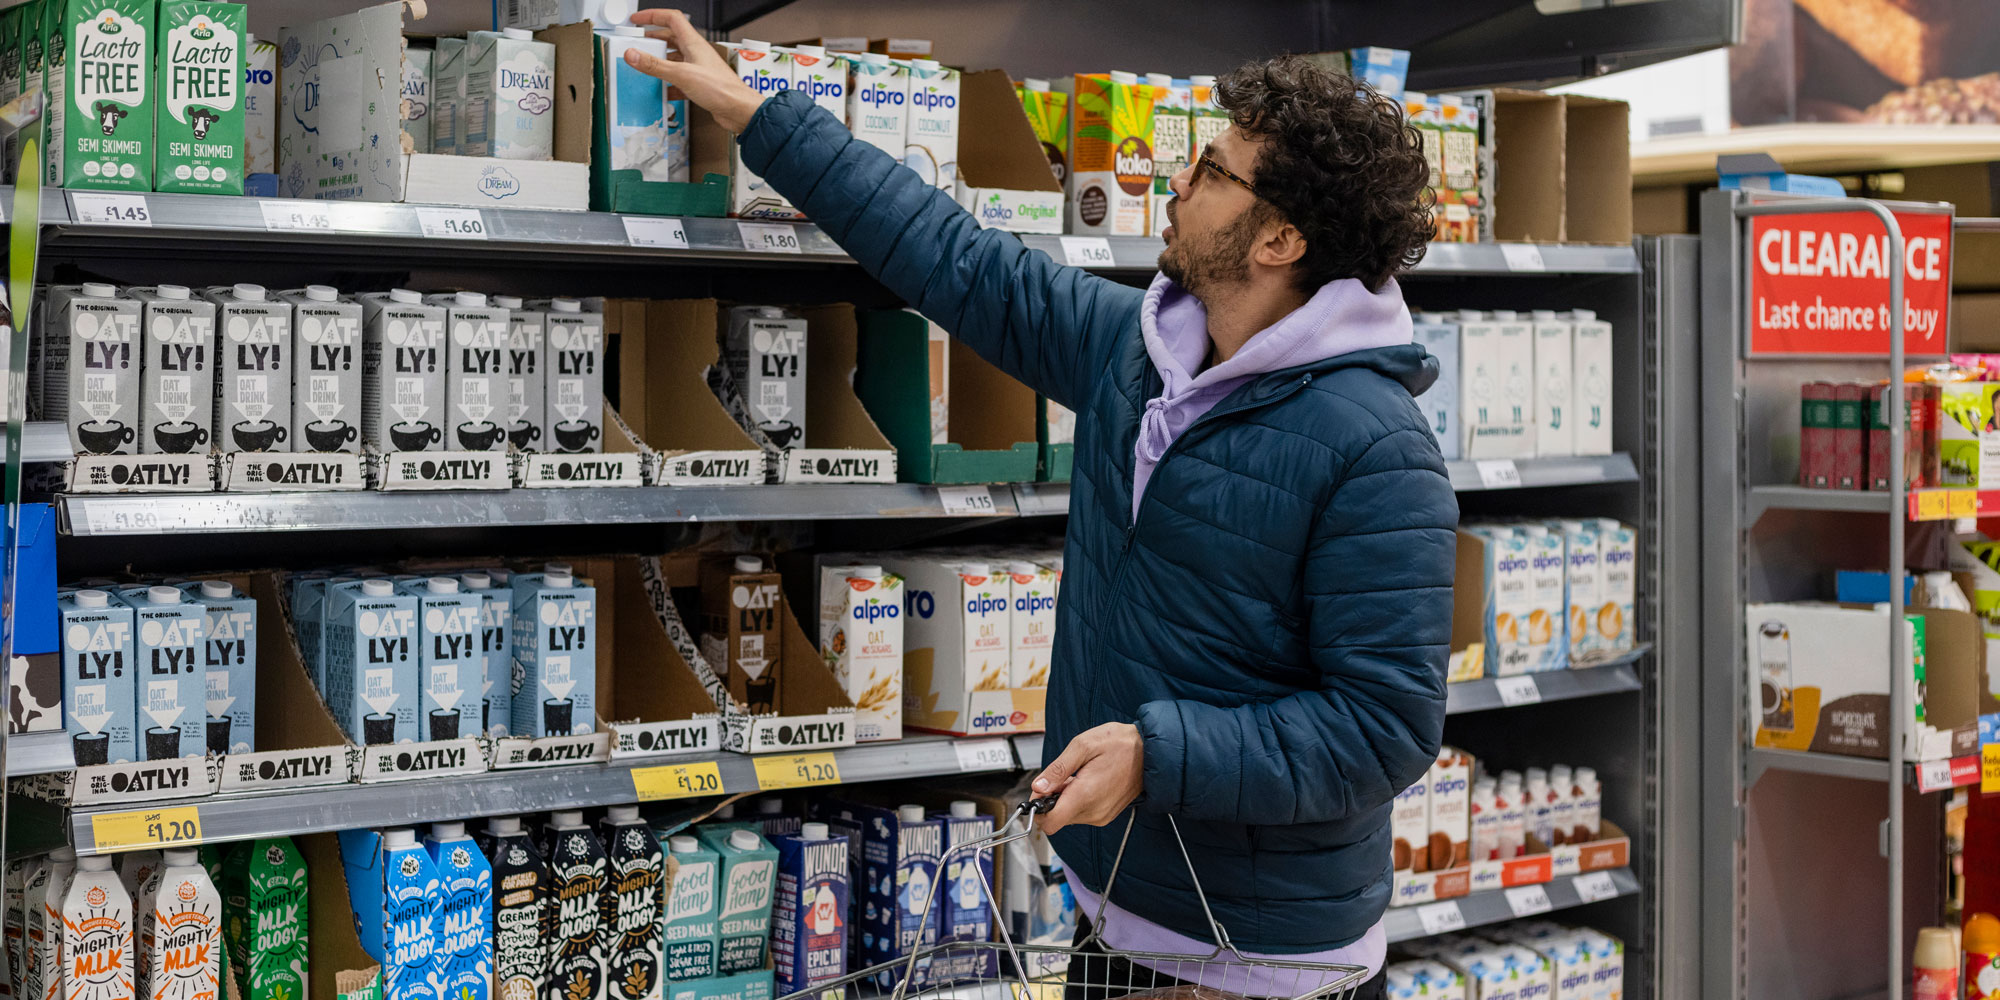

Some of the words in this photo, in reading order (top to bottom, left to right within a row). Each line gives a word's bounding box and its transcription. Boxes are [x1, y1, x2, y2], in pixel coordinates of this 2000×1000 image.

[100, 23, 118, 32] Arla
[192, 29, 210, 38] Arla
[80, 36, 140, 59] Lacto
[172, 41, 233, 64] Lacto
[81, 62, 138, 94] FREE
[173, 66, 230, 99] FREE
[501, 69, 549, 91] DREAM
[797, 74, 842, 102] alpro
[861, 83, 904, 109] alpro
[913, 87, 955, 111] alpro
[78, 138, 99, 152] SEMI
[103, 139, 141, 155] SKIMMED
[170, 143, 190, 156] SEMI
[194, 144, 232, 158] SKIMMED
[1115, 152, 1152, 176] koko
[485, 176, 512, 190] DREAM
[106, 206, 147, 221] £1.45
[982, 204, 1012, 220] koko
[1018, 204, 1057, 220] Original
[445, 219, 482, 234] £1.60
[674, 230, 686, 242] £1
[764, 235, 796, 248] £1.80
[75, 313, 139, 341] OAT-
[152, 315, 212, 343] OAT-
[227, 316, 287, 343] OAT-
[301, 317, 359, 343] OAT-
[1759, 297, 1799, 329] Last
[1805, 296, 1873, 331] chance
[1905, 298, 1938, 340] buy
[454, 322, 508, 347] OAT-
[85, 342, 130, 369] LY!
[161, 344, 204, 371] LY!
[238, 344, 280, 370] LY!
[310, 345, 352, 371] LY!
[463, 348, 500, 374] LY!
[87, 377, 104, 389] OAT
[87, 390, 114, 402] DRINK
[111, 463, 190, 485] OATLY!
[266, 462, 342, 484] OATLY!
[420, 460, 490, 481] OATLY!
[558, 462, 623, 481] OATLY!
[816, 458, 878, 477] OATLY!
[966, 496, 991, 509] £1.15
[116, 513, 157, 528] £1.80
[732, 585, 779, 609] OAT-
[967, 593, 1007, 618] alpro
[1015, 591, 1054, 615] alpro
[359, 610, 415, 637] OAT-
[425, 607, 479, 634] OAT-
[741, 609, 774, 632] LY!
[853, 599, 899, 624] alpro
[67, 623, 130, 651] OAT-
[141, 618, 202, 647] OAT-
[868, 630, 884, 644] OAT
[980, 624, 994, 637] OAT
[369, 637, 408, 663] LY!
[435, 634, 473, 660] LY!
[78, 651, 123, 679] LY!
[152, 648, 194, 674] LY!
[78, 693, 93, 705] OAT
[78, 703, 104, 716] DRINK
[973, 711, 1007, 731] alpro
[638, 726, 707, 751] OATLY!
[778, 722, 844, 745] OATLY!
[258, 755, 332, 780] OATLY!
[397, 748, 466, 771] OATLY!
[111, 767, 189, 793] OATLY!
[678, 773, 718, 792] £1.20
[797, 763, 835, 782] £1.20
[148, 820, 196, 842] £1.20
[899, 825, 941, 856] WUNDA
[567, 865, 592, 876] BARISTA
[804, 842, 847, 881] WUNDA
[617, 873, 658, 895] MIGHTY
[732, 862, 769, 890] good
[257, 888, 300, 912] MIGHTY
[400, 889, 420, 898] WHOLE
[560, 879, 601, 901] MIGHTY
[618, 886, 655, 916] M.LK
[730, 887, 766, 910] Hemp
[393, 899, 434, 925] MIGHTY
[443, 891, 485, 915] MIGHTY
[560, 892, 599, 922] M.LK
[672, 890, 709, 915] Hemp
[81, 918, 120, 931] UNSWEETENED
[258, 903, 299, 934] M.LK
[444, 905, 483, 937] M.LK
[500, 910, 536, 922] CREAMY
[560, 911, 600, 940] OLOGY
[618, 905, 656, 934] OLOGY
[721, 920, 741, 934] SEED
[163, 927, 212, 952] MIGHTY
[258, 925, 299, 951] OLOGY
[394, 915, 433, 947] M.LK
[444, 927, 484, 955] OLOGY
[667, 926, 687, 940] SEED
[73, 934, 125, 957] MIGHTY
[394, 936, 435, 966] OLOGY
[74, 948, 123, 979] M.LK
[164, 943, 210, 973] M.LK
[500, 950, 538, 968] Perfect
[670, 957, 692, 968] SUGAR
[694, 955, 709, 965] FREE
[808, 951, 829, 968] EPIC
[831, 949, 841, 964] IN
[501, 967, 515, 979] FOR
[517, 965, 536, 976] YOUR
